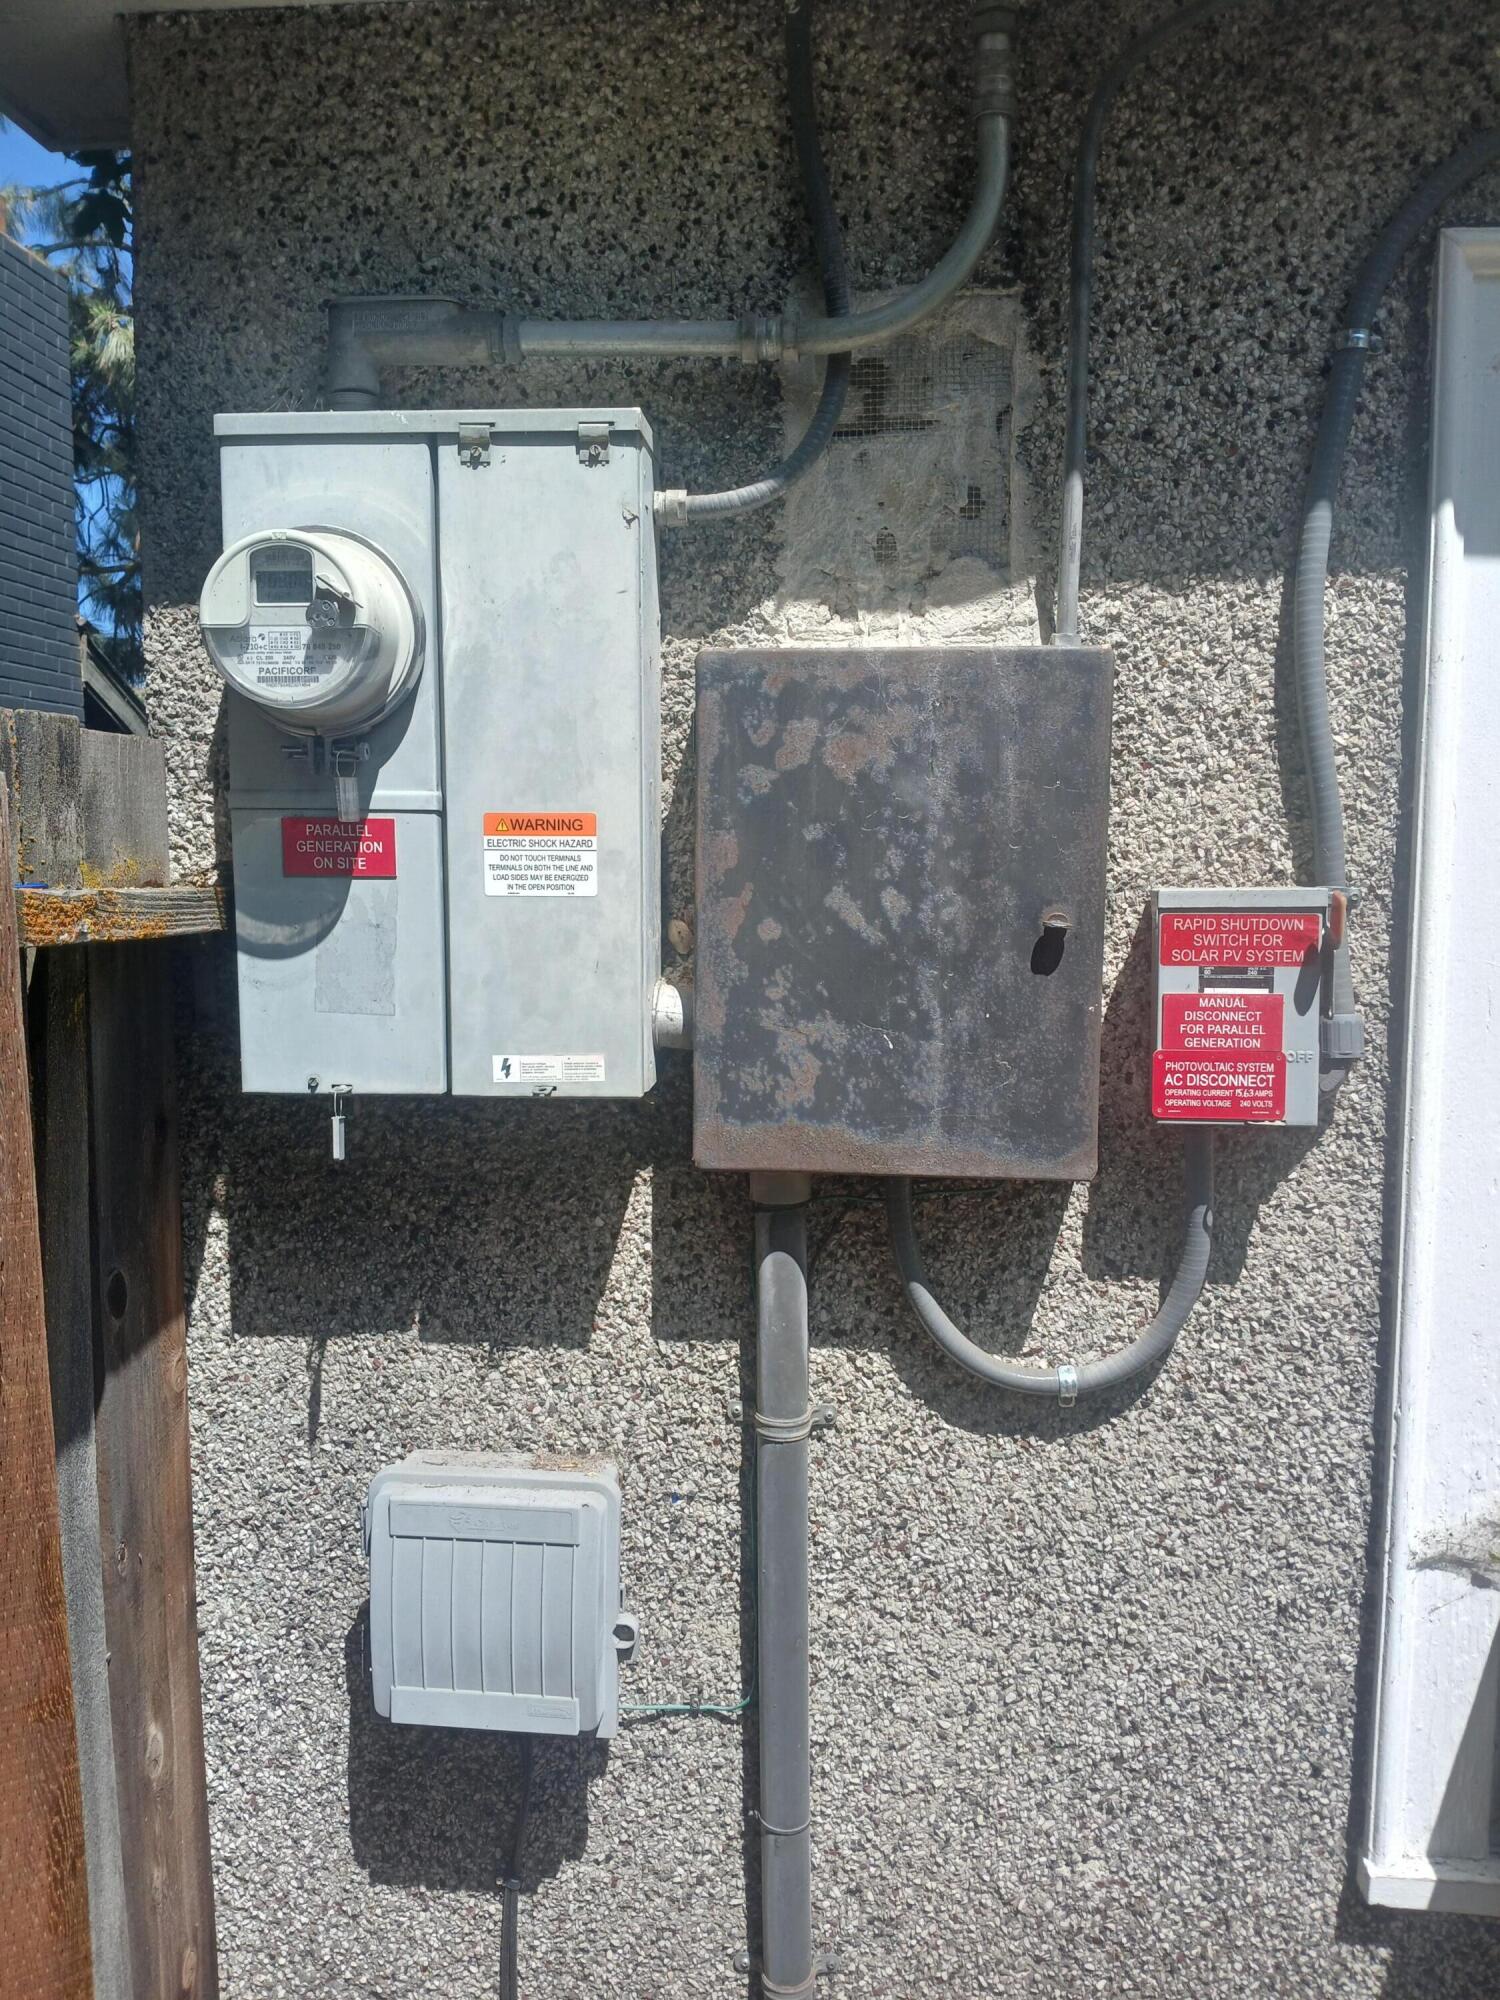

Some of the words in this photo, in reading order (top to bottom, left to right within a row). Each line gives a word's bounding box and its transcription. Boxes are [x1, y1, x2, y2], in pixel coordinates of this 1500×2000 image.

[509, 818, 584, 831] WARNING
[306, 824, 373, 837] PARALLEL
[296, 840, 383, 853] GENERATION
[487, 838, 527, 848] ELECTRIC
[528, 839, 557, 848] SHOCK
[559, 839, 593, 848] HAZARD
[313, 857, 333, 869] ON
[337, 857, 367, 869] SITE
[499, 854, 509, 862] DO
[510, 854, 523, 862] NOT
[525, 854, 546, 862] TOUCH
[552, 864, 564, 872] THE
[492, 873, 509, 881] LOAD
[510, 873, 529, 881] SIDES
[528, 883, 545, 891] OPEN
[1173, 918, 1216, 931] RAPID
[1220, 918, 1304, 931] SHUTDOWN
[1193, 934, 1249, 946] SWITCH
[1253, 934, 1283, 946] FOR
[1171, 949, 1219, 962] SOLAR
[1223, 950, 1242, 962] PV
[1245, 950, 1305, 962] SYSTEM
[1199, 998, 1248, 1008] MANUAL
[1184, 1011, 1262, 1021] DISCONNECT
[1180, 1024, 1204, 1034] FOR
[1207, 1024, 1266, 1034] PARALLEL
[1184, 1037, 1261, 1048] GENERATION
[1286, 1050, 1313, 1063] OFF
[1165, 1061, 1234, 1072] PHOTOVOLTAIC
[1236, 1062, 1275, 1072] SYSTEM
[1164, 1073, 1183, 1086] AC
[1186, 1074, 1276, 1087] DISCONNECT
[1202, 1089, 1234, 1097] CURRENT
[1254, 1089, 1274, 1097] AMPS
[1202, 1099, 1232, 1107] VOLTAGE
